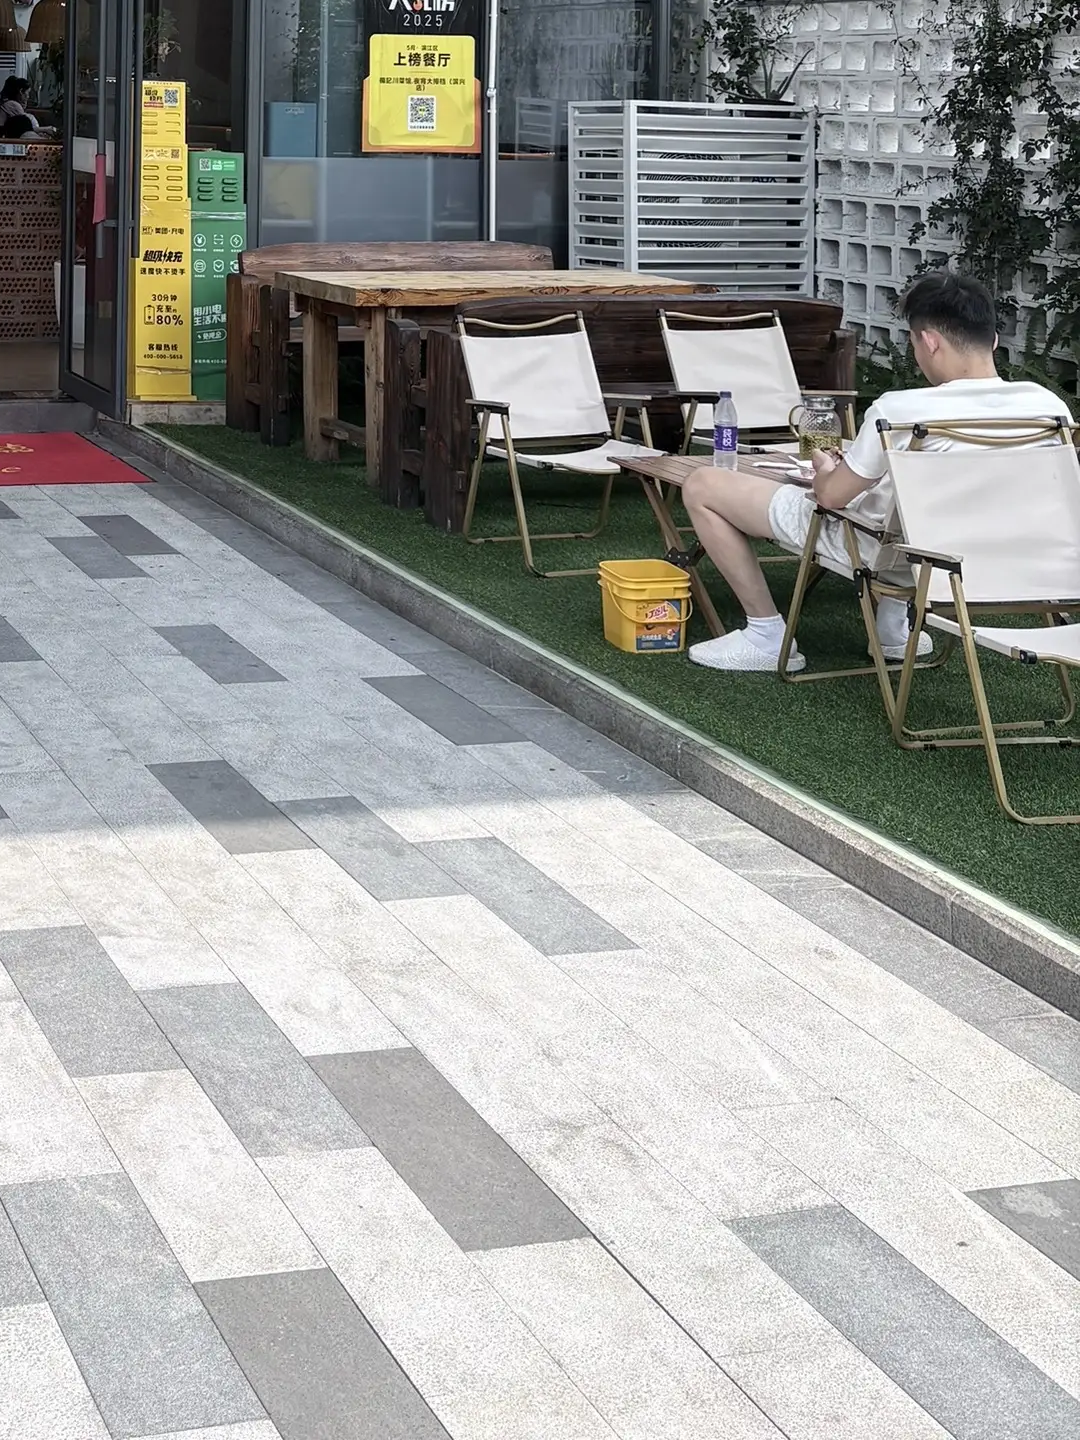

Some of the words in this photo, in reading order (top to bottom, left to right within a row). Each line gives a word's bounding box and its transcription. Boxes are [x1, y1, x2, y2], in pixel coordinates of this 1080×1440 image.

[403, 14, 444, 28] 2025
[393, 52, 451, 68] 上榜餐厅
[142, 247, 184, 264] 超级快充
[151, 293, 178, 302] 30分钟
[156, 314, 184, 326] 80%
